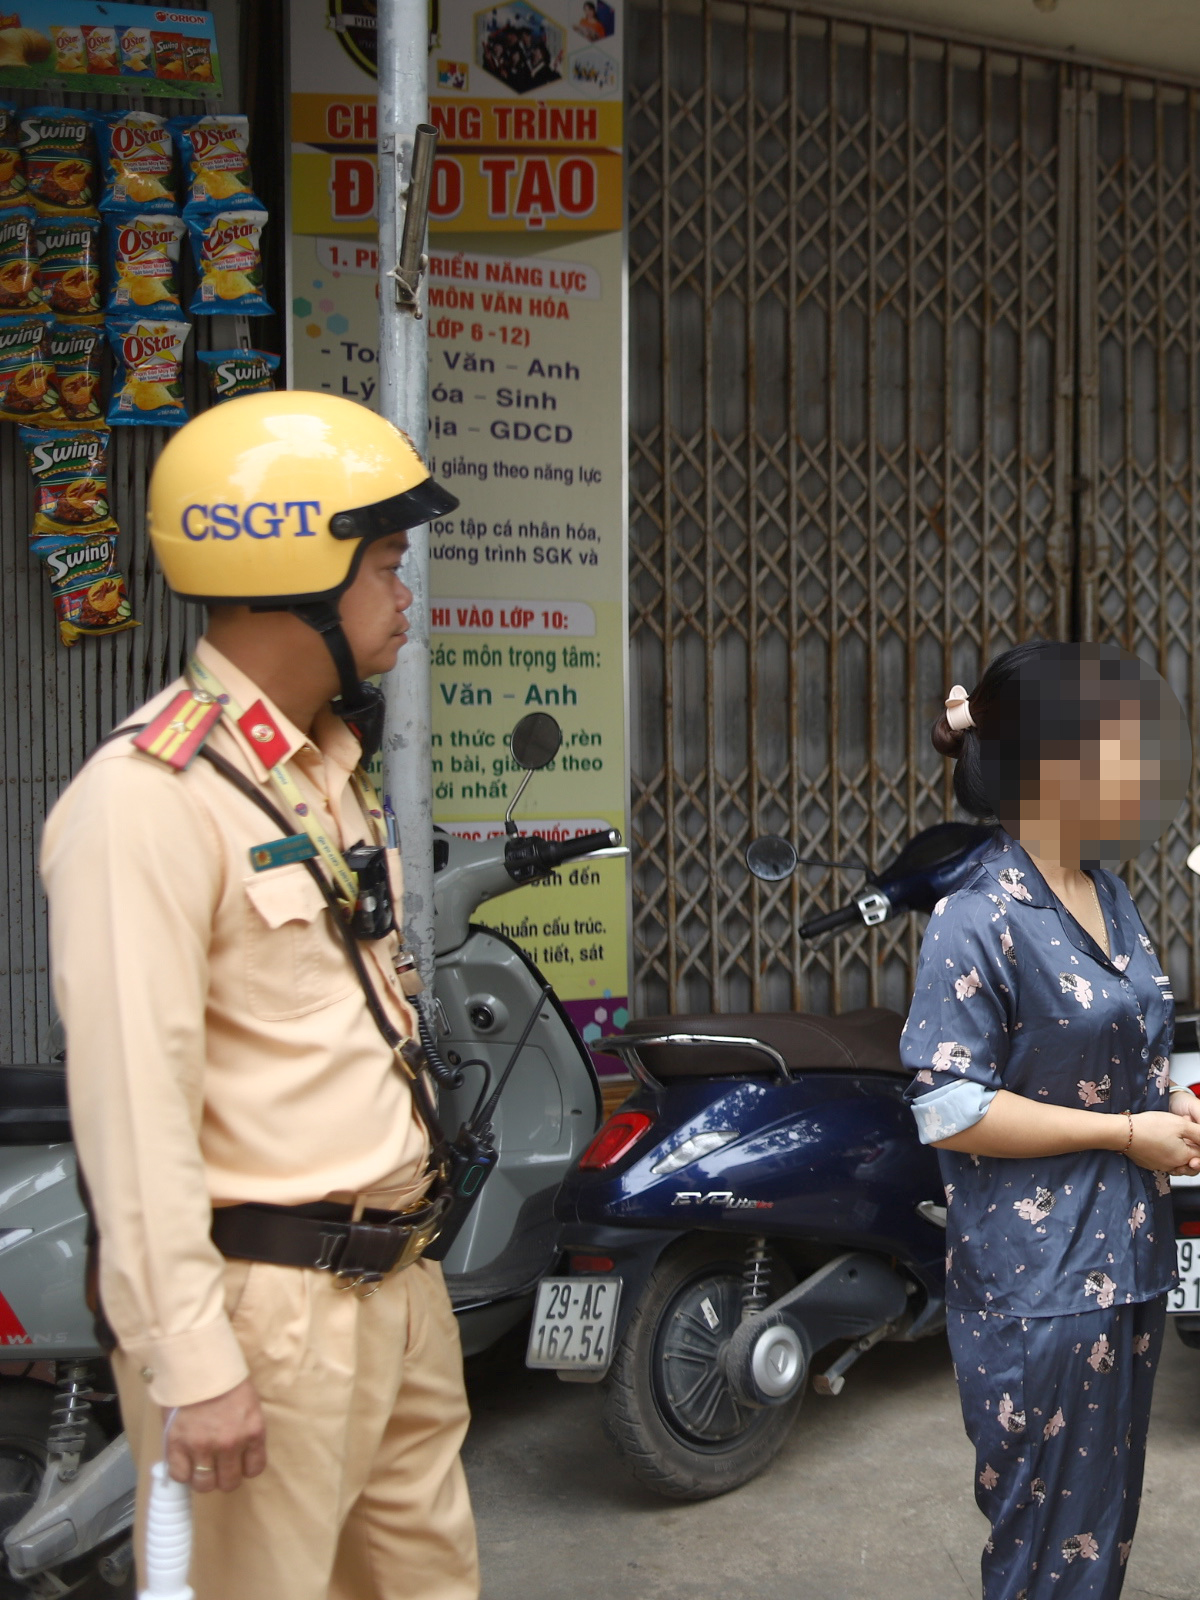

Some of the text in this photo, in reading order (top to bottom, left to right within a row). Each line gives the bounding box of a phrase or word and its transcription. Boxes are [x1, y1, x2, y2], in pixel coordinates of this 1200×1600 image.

[169, 14, 206, 25] ORION
[327, 94, 597, 141] CHNG TRÌNH
[19, 118, 86, 149] Swing
[332, 158, 595, 227] ĐO TẠO
[430, 252, 479, 283] RIỂN
[486, 265, 543, 288] NĂNG
[550, 271, 587, 294] LỰC
[481, 292, 522, 315] VĂN
[530, 298, 570, 320] HÓA
[443, 350, 496, 373] Văn
[527, 358, 581, 380] Anh
[341, 375, 376, 401] Lý
[431, 383, 464, 403] óa
[496, 388, 558, 411] Sinh
[428, 417, 458, 439] ịa
[490, 421, 574, 443] GDCD
[31, 440, 99, 475] Swing
[442, 456, 488, 480] giảng
[493, 461, 530, 479] theo
[534, 463, 574, 486] năng
[579, 466, 602, 487] lực
[181, 501, 321, 541] CSGT
[460, 519, 488, 539] tập
[493, 519, 513, 537] cá
[518, 521, 561, 540] nhân
[566, 522, 602, 544] hóa,
[47, 542, 109, 583] Swing
[485, 546, 527, 563] trình
[532, 546, 573, 565] SGK
[578, 551, 599, 566] và
[430, 604, 569, 630] HI VÀO LỚP 10:
[462, 644, 503, 667] môn
[508, 644, 557, 674] trọng
[561, 646, 602, 669] tâm:
[440, 682, 493, 706] Văn
[524, 683, 578, 706] Anh
[451, 729, 496, 747] thức
[450, 755, 486, 775] bài,
[561, 755, 603, 772] theo
[461, 780, 509, 799] nhất
[569, 864, 601, 886] đến
[542, 915, 570, 937] cấu
[574, 917, 608, 934] trúc.
[543, 943, 574, 965] tiết,
[579, 943, 604, 962] sát
[546, 1284, 608, 1321] 29-AC
[537, 1325, 606, 1362] 162.54
